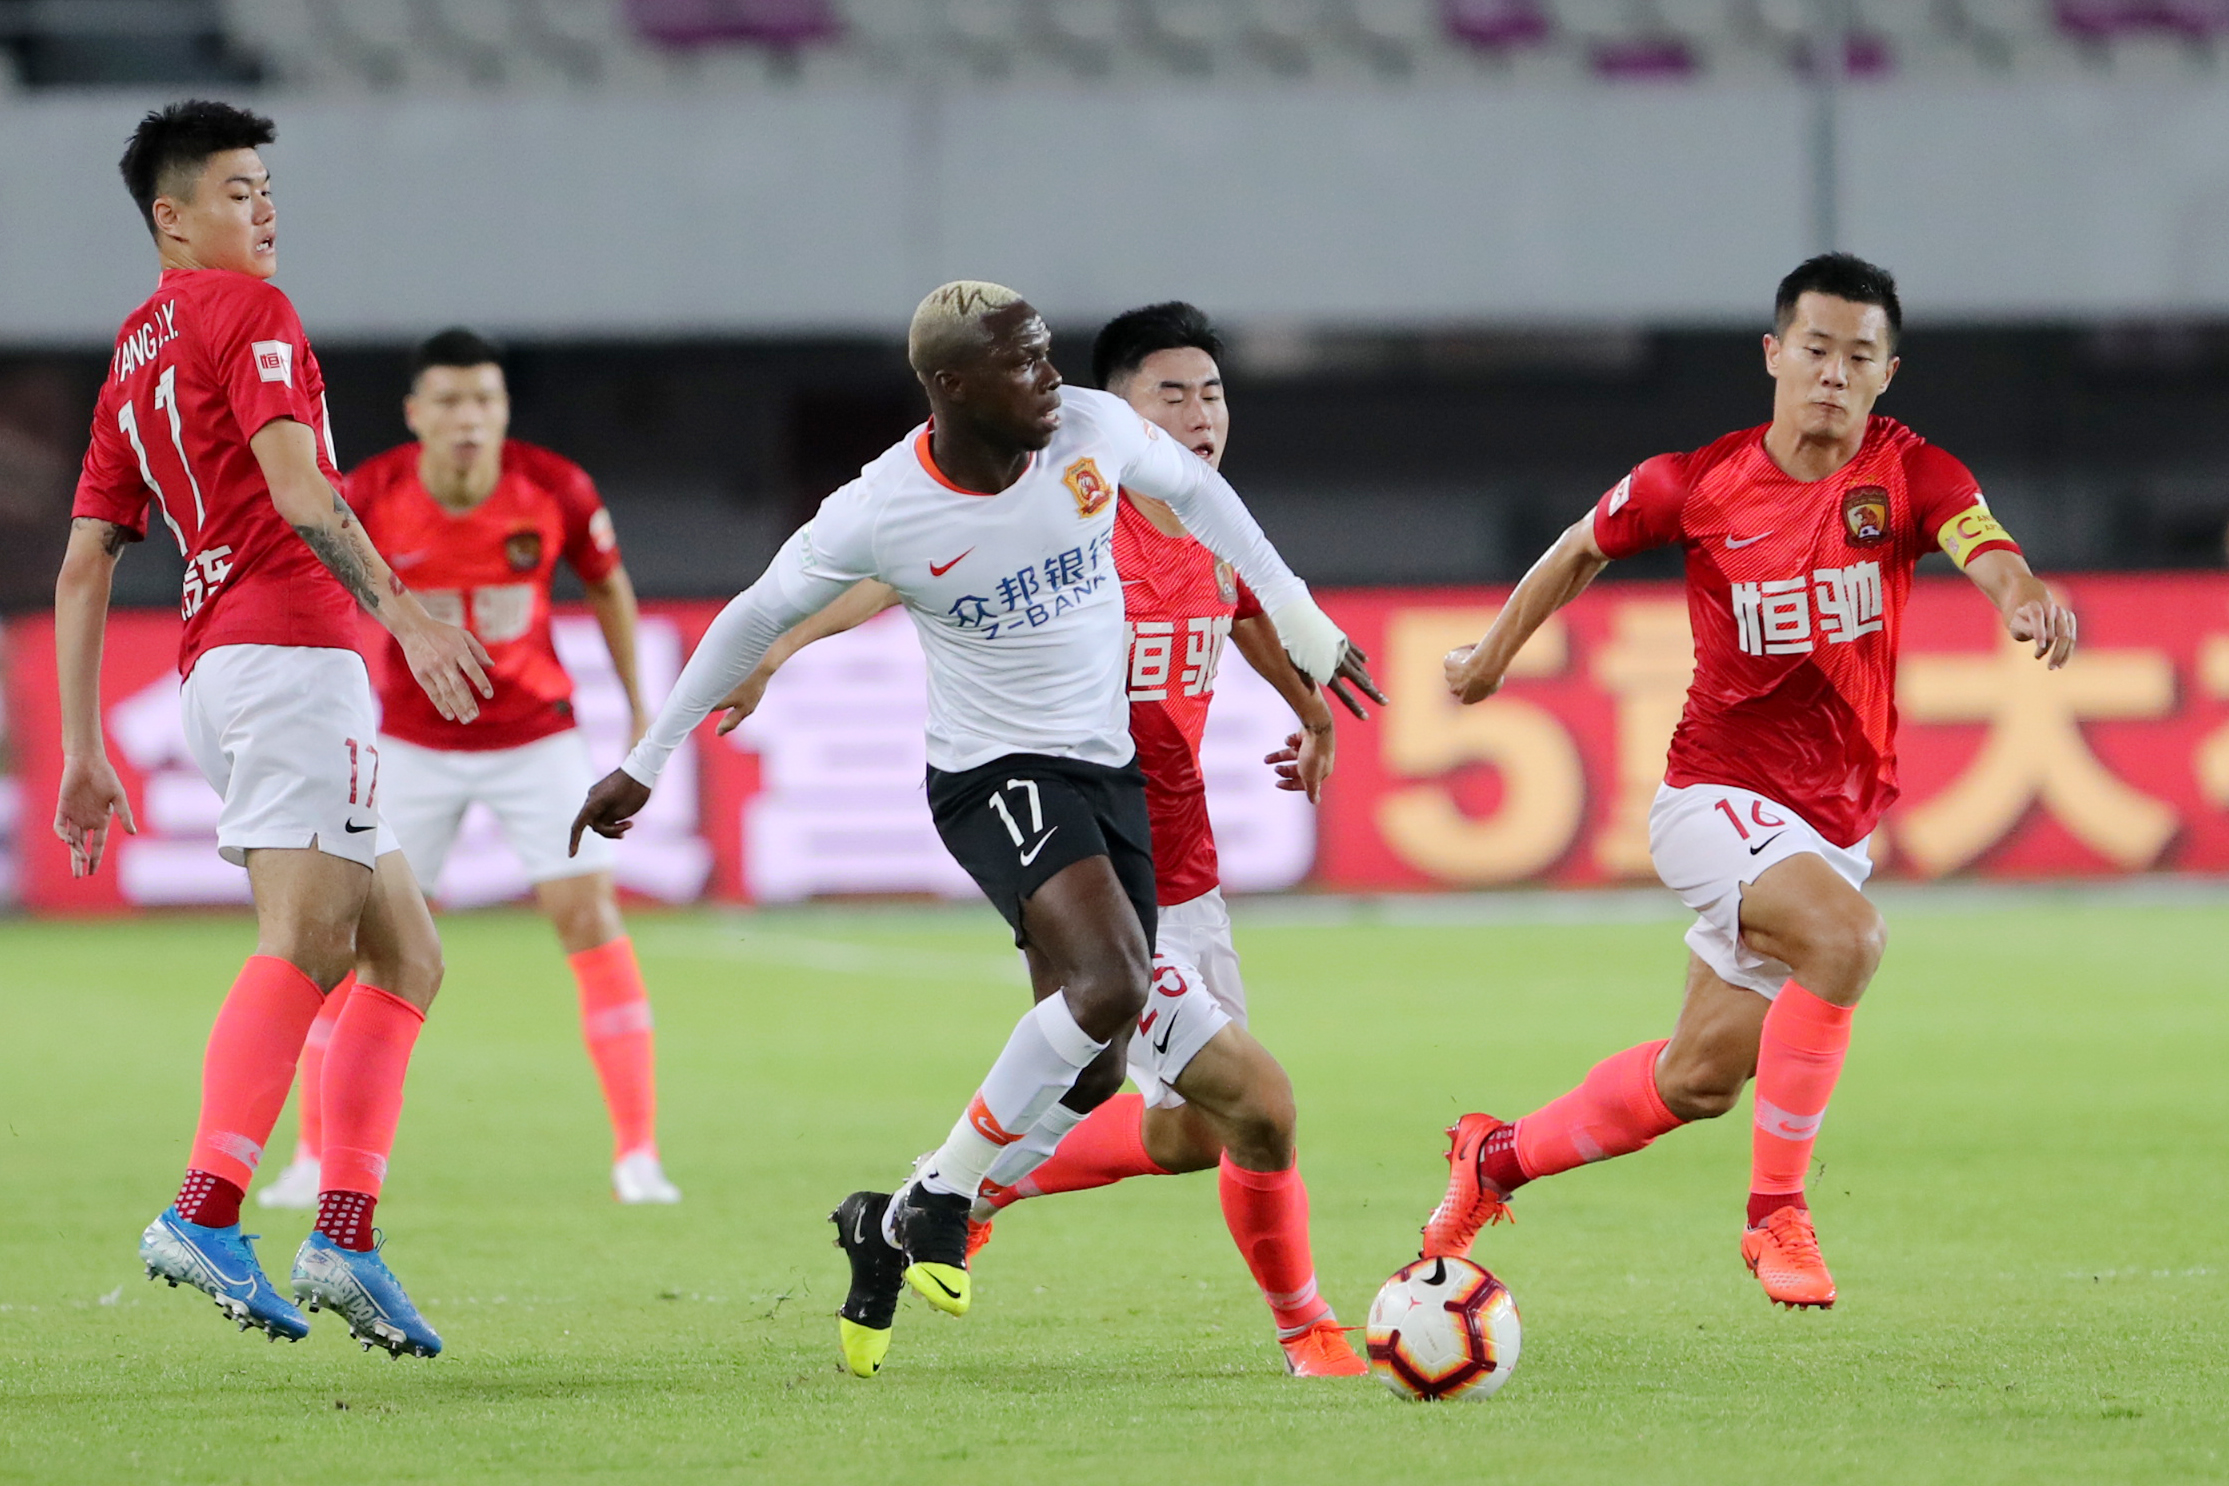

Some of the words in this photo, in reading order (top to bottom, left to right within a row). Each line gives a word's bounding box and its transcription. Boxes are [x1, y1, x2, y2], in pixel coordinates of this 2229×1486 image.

[1731, 560, 1883, 656] 恒驰
[988, 778, 1043, 848] 17
[1714, 798, 1785, 840] 16
[1137, 953, 1187, 1037] 5
